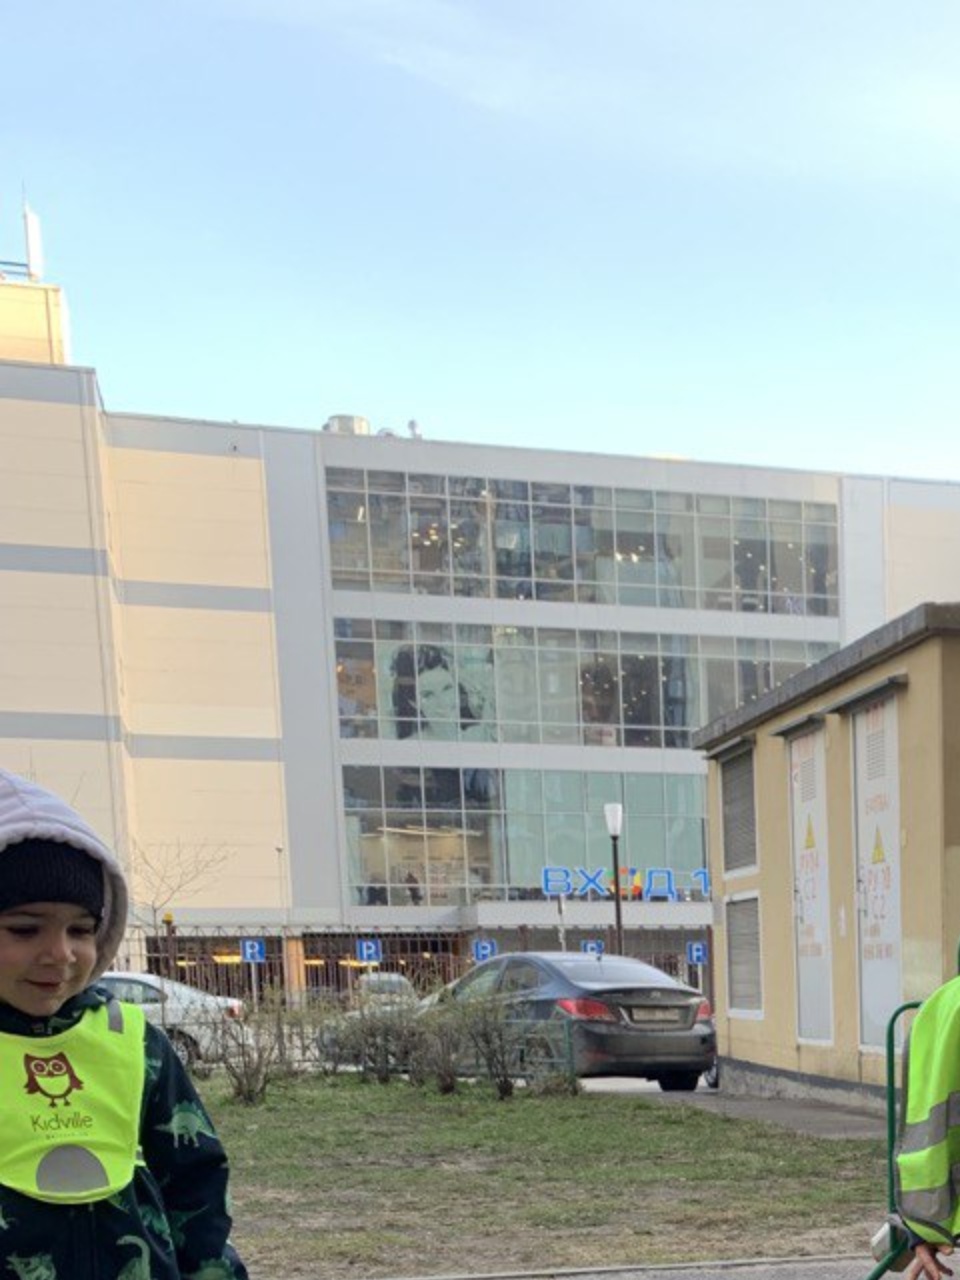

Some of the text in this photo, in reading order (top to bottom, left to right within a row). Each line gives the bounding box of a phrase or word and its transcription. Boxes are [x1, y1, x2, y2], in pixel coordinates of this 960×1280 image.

[245, 940, 259, 959] P
[363, 941, 376, 960] P
[479, 941, 492, 961] P
[692, 942, 703, 962] P
[31, 1112, 93, 1131] Kidville
